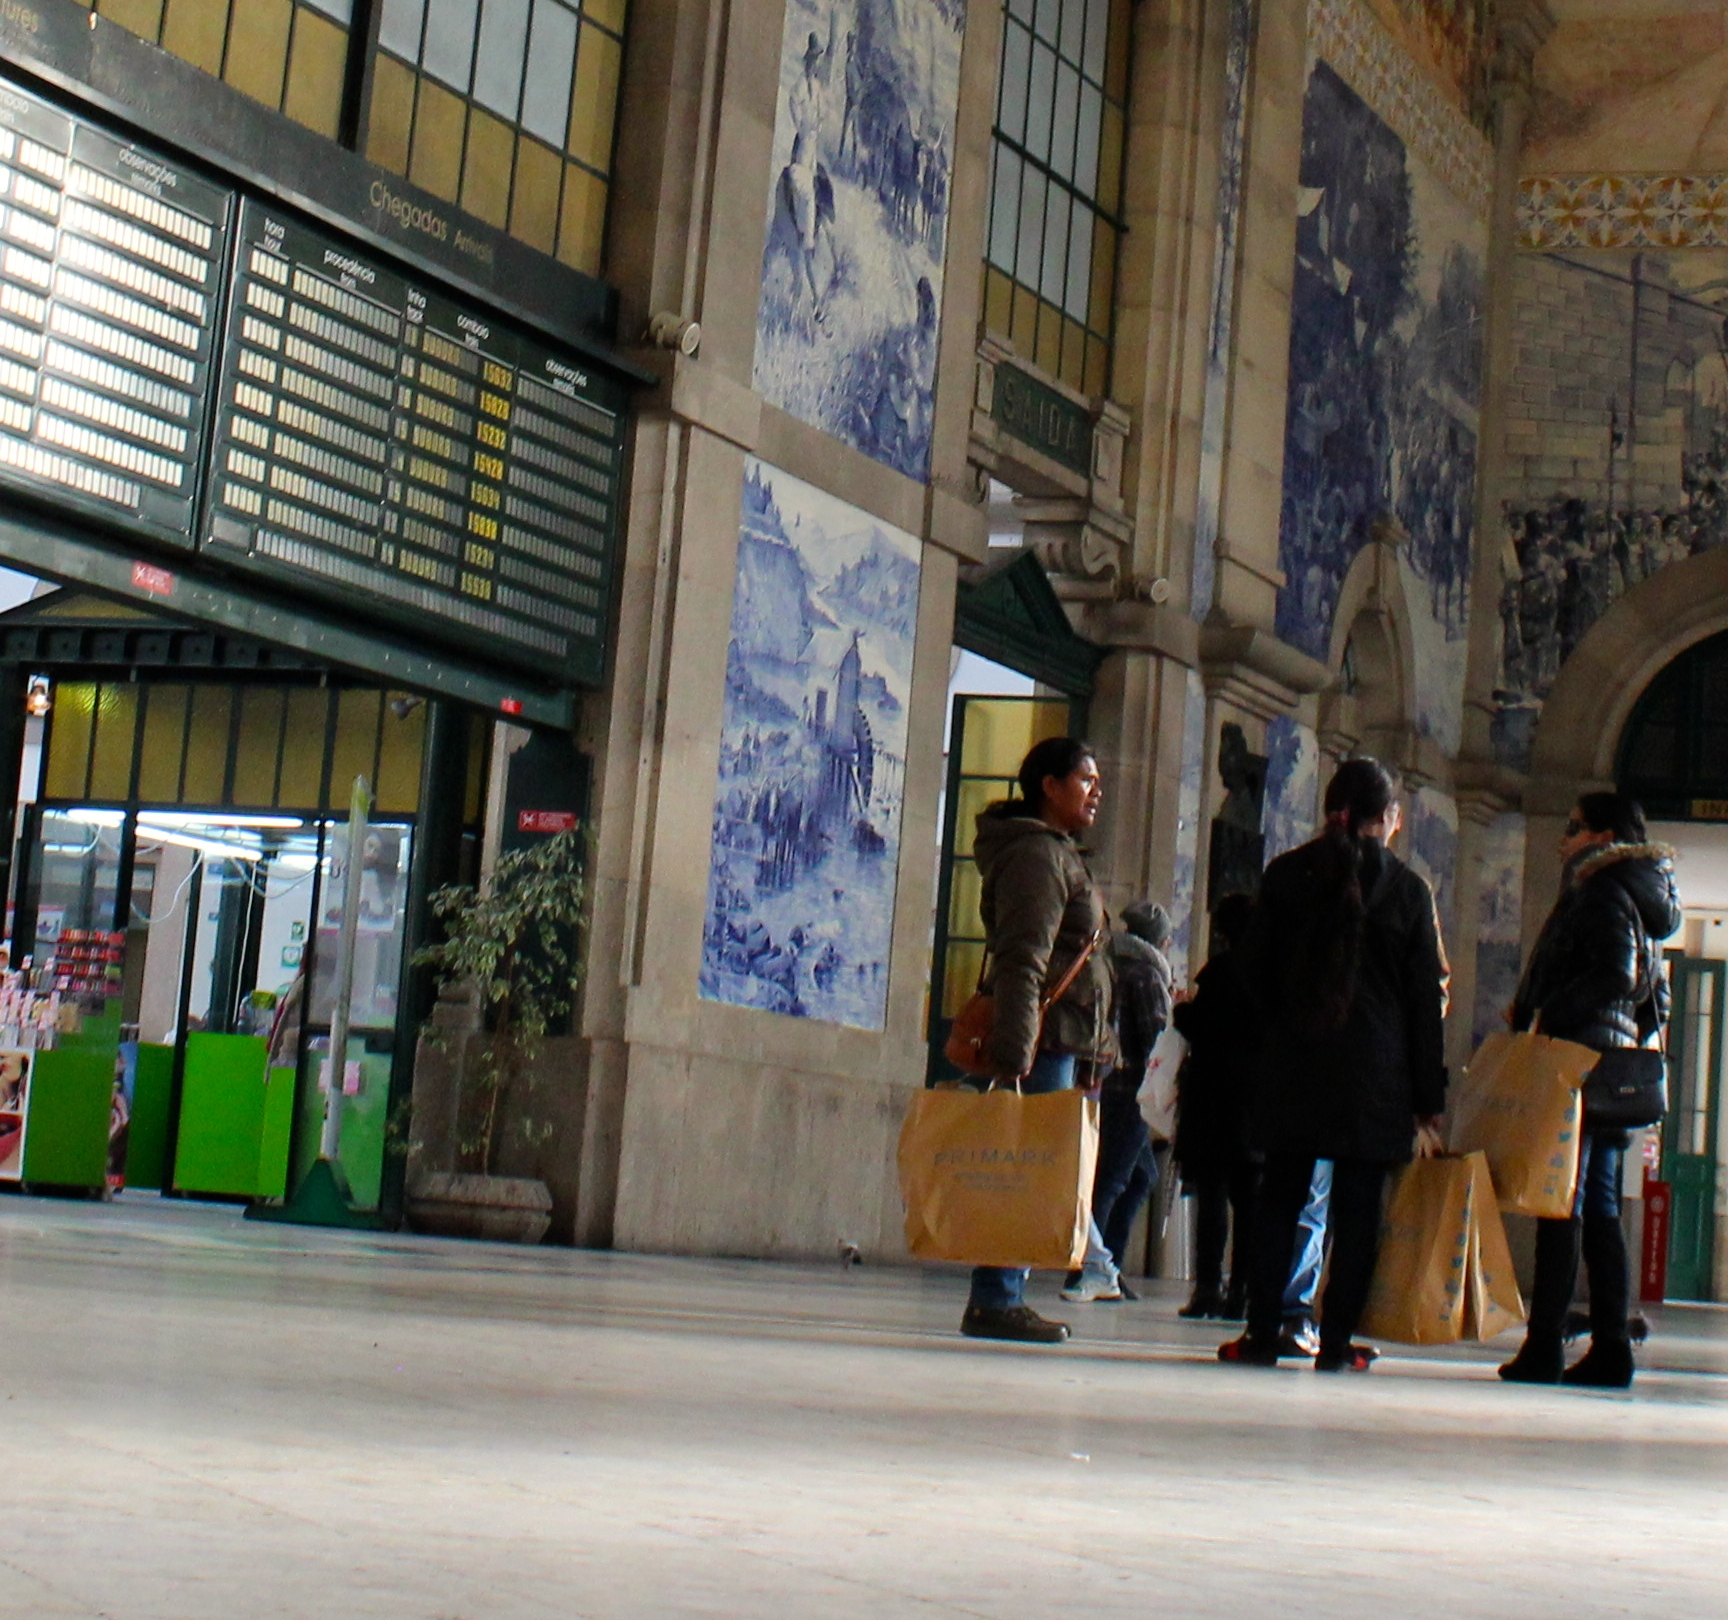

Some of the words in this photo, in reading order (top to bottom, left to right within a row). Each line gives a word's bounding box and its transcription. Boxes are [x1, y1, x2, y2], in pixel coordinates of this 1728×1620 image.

[119, 148, 178, 189] observações
[370, 180, 450, 242] Chegadas
[263, 216, 285, 239] hora
[934, 1148, 1056, 1167] PRIMARK
